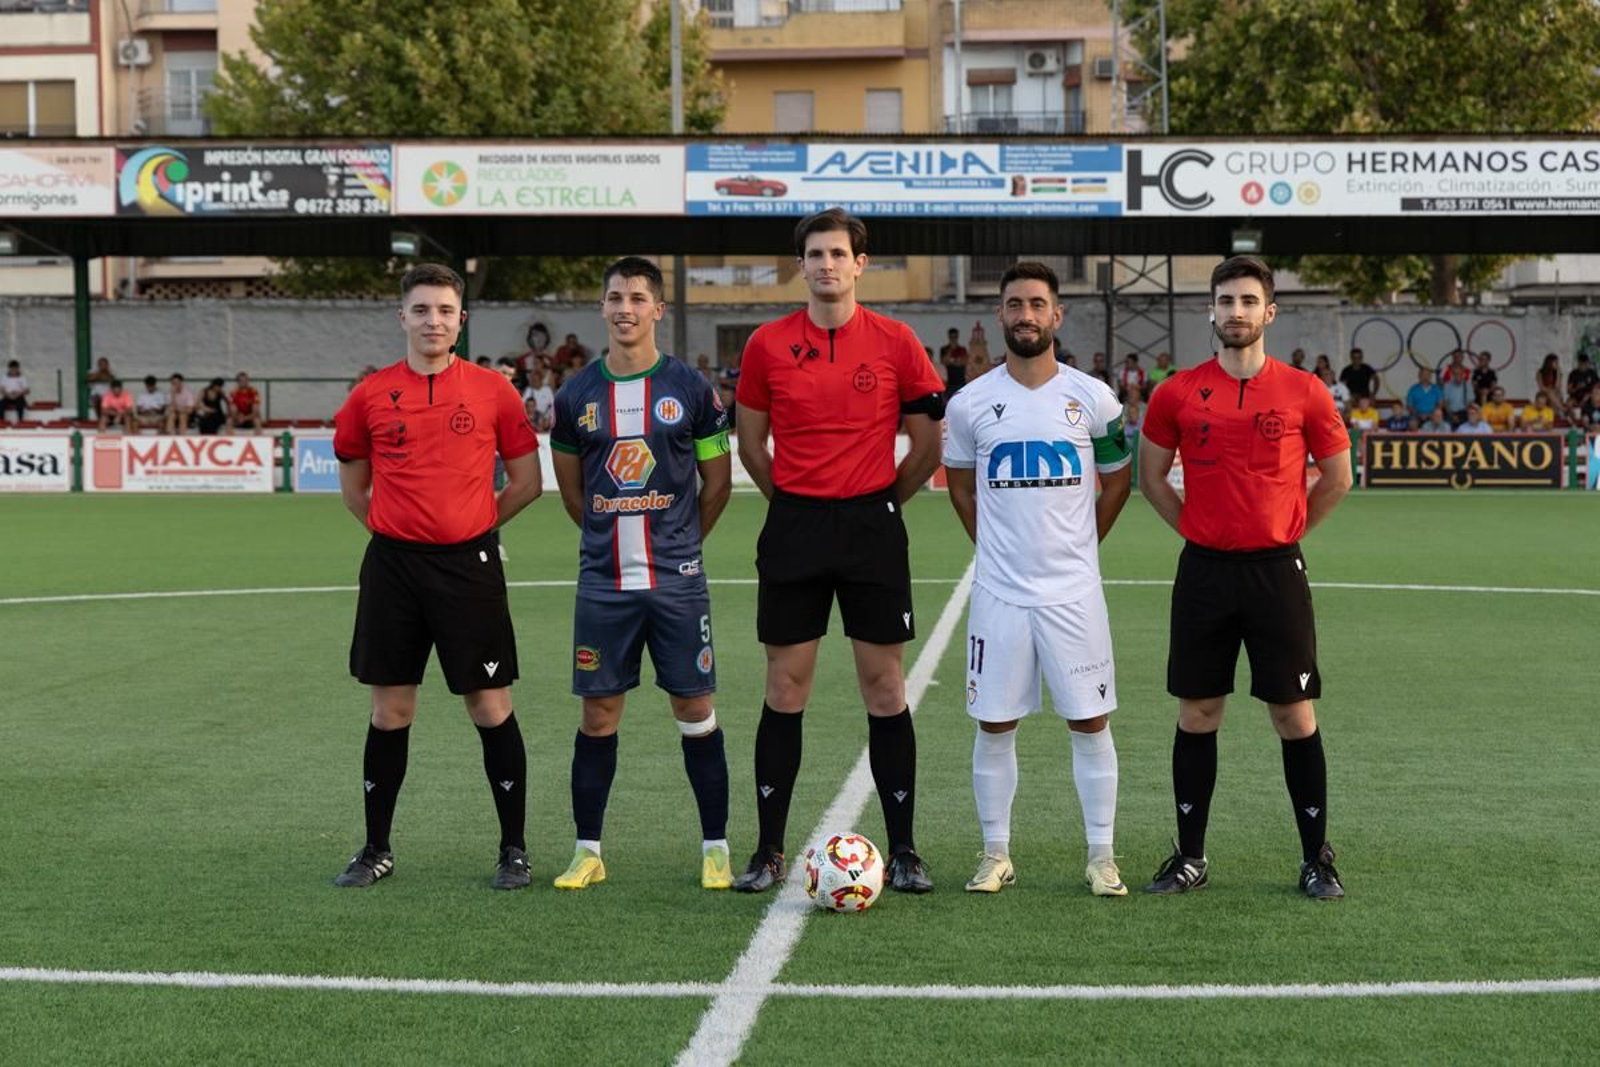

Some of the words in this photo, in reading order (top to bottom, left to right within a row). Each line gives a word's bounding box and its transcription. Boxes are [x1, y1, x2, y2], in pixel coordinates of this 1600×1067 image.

[264, 150, 303, 165] DIGITAL
[305, 150, 337, 165] GRAN
[338, 150, 390, 165] FORMATO
[526, 154, 538, 164] DE
[540, 154, 572, 164] ACEITES
[575, 154, 622, 164] VEGETALES
[625, 154, 660, 164] USADOS
[1225, 152, 1336, 174] GRUPO
[1347, 151, 1528, 173] HERMANOS
[1539, 151, 1600, 172] CAS
[477, 168, 567, 181] RECICLADOS
[1346, 177, 1423, 193] Extinción
[1437, 177, 1551, 193] Climatización
[477, 186, 507, 206] LA
[516, 186, 638, 206] ESTRELLA
[128, 440, 263, 475] MAYCA
[1372, 440, 1553, 469] HISPANO
[593, 491, 674, 512] Duracolor
[700, 615, 711, 642] 5
[970, 635, 985, 674] 11
